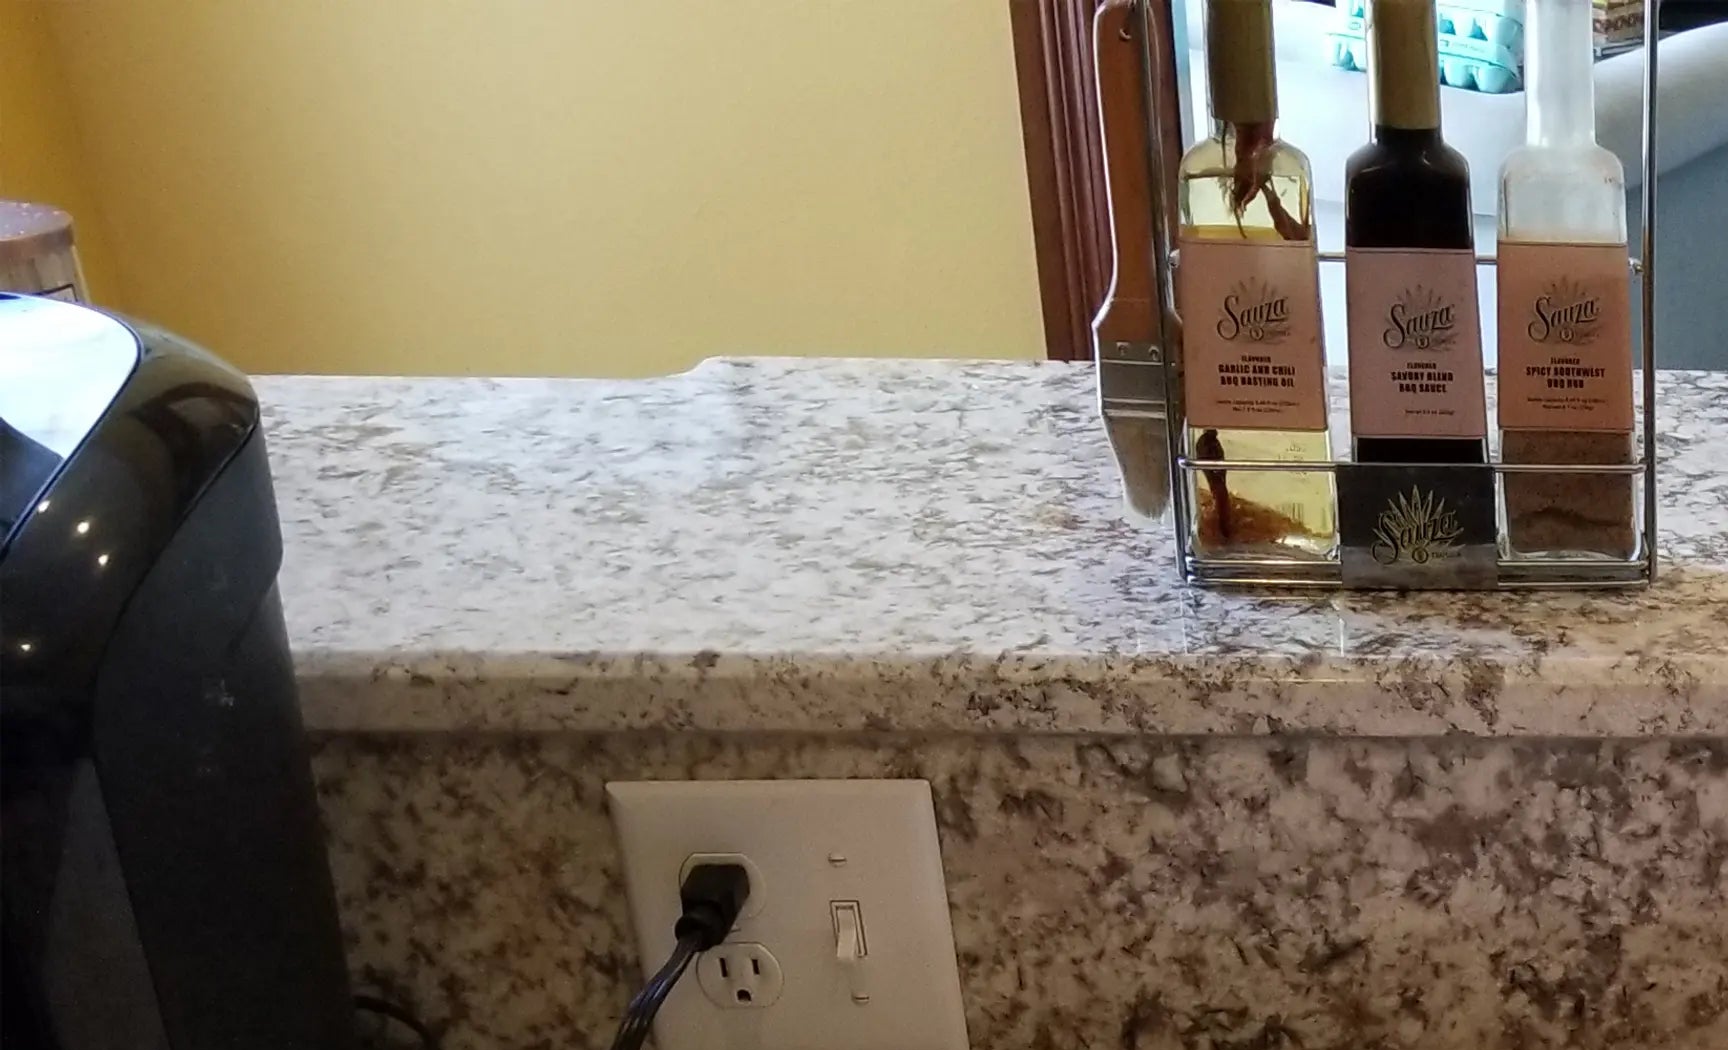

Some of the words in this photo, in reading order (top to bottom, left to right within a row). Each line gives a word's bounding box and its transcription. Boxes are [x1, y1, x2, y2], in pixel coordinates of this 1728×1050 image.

[1216, 295, 1289, 341] Sauza
[1527, 296, 1599, 343] Sauza
[1383, 304, 1454, 349] Sauza
[1218, 364, 1250, 374] GARLIC
[1252, 364, 1270, 375] AND
[1272, 365, 1296, 376] CHILI
[1526, 366, 1551, 377] SPICY
[1553, 367, 1606, 378] SOUTHWEST
[1220, 376, 1239, 387] BBQ
[1240, 376, 1279, 387] BASTING
[1280, 377, 1295, 388] OIL
[1391, 371, 1425, 381] SAVORY
[1426, 372, 1454, 382] BLEND
[1399, 383, 1417, 394] BBQ
[1418, 383, 1448, 393] SAUCE
[1547, 378, 1565, 389] BBQ
[1567, 379, 1585, 389] RUB
